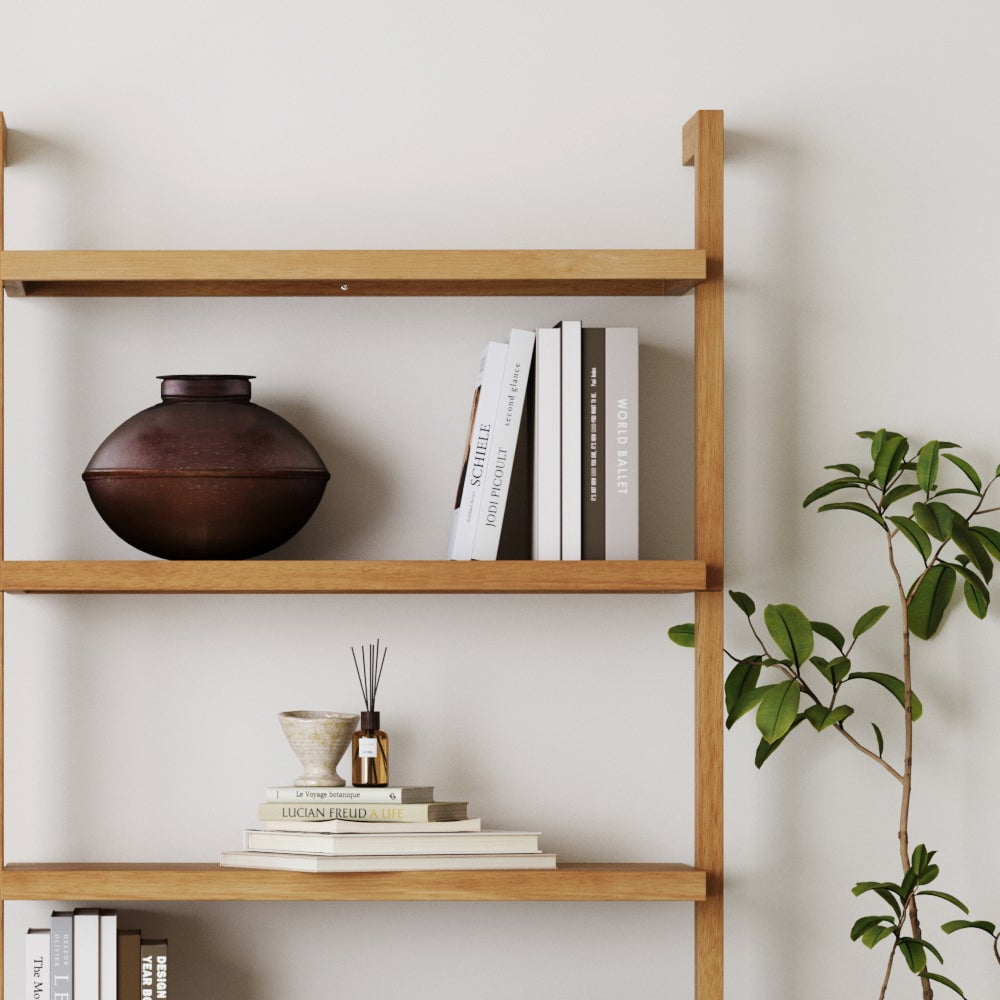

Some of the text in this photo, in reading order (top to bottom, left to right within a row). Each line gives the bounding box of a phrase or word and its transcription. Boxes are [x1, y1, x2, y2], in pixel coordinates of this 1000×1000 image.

[505, 362, 521, 426] second glance
[471, 424, 490, 487] SCHIELE
[616, 398, 628, 495] WORLD BALLET
[486, 447, 508, 527] JODI PICOULT
[282, 807, 404, 819] LUCIAN FREUD A LIFE
[305, 791, 327, 800] Voyage
[329, 790, 360, 800] botanique
[33, 957, 44, 978] The
[142, 955, 153, 986] YEAR
[156, 956, 167, 998] DESIGN
